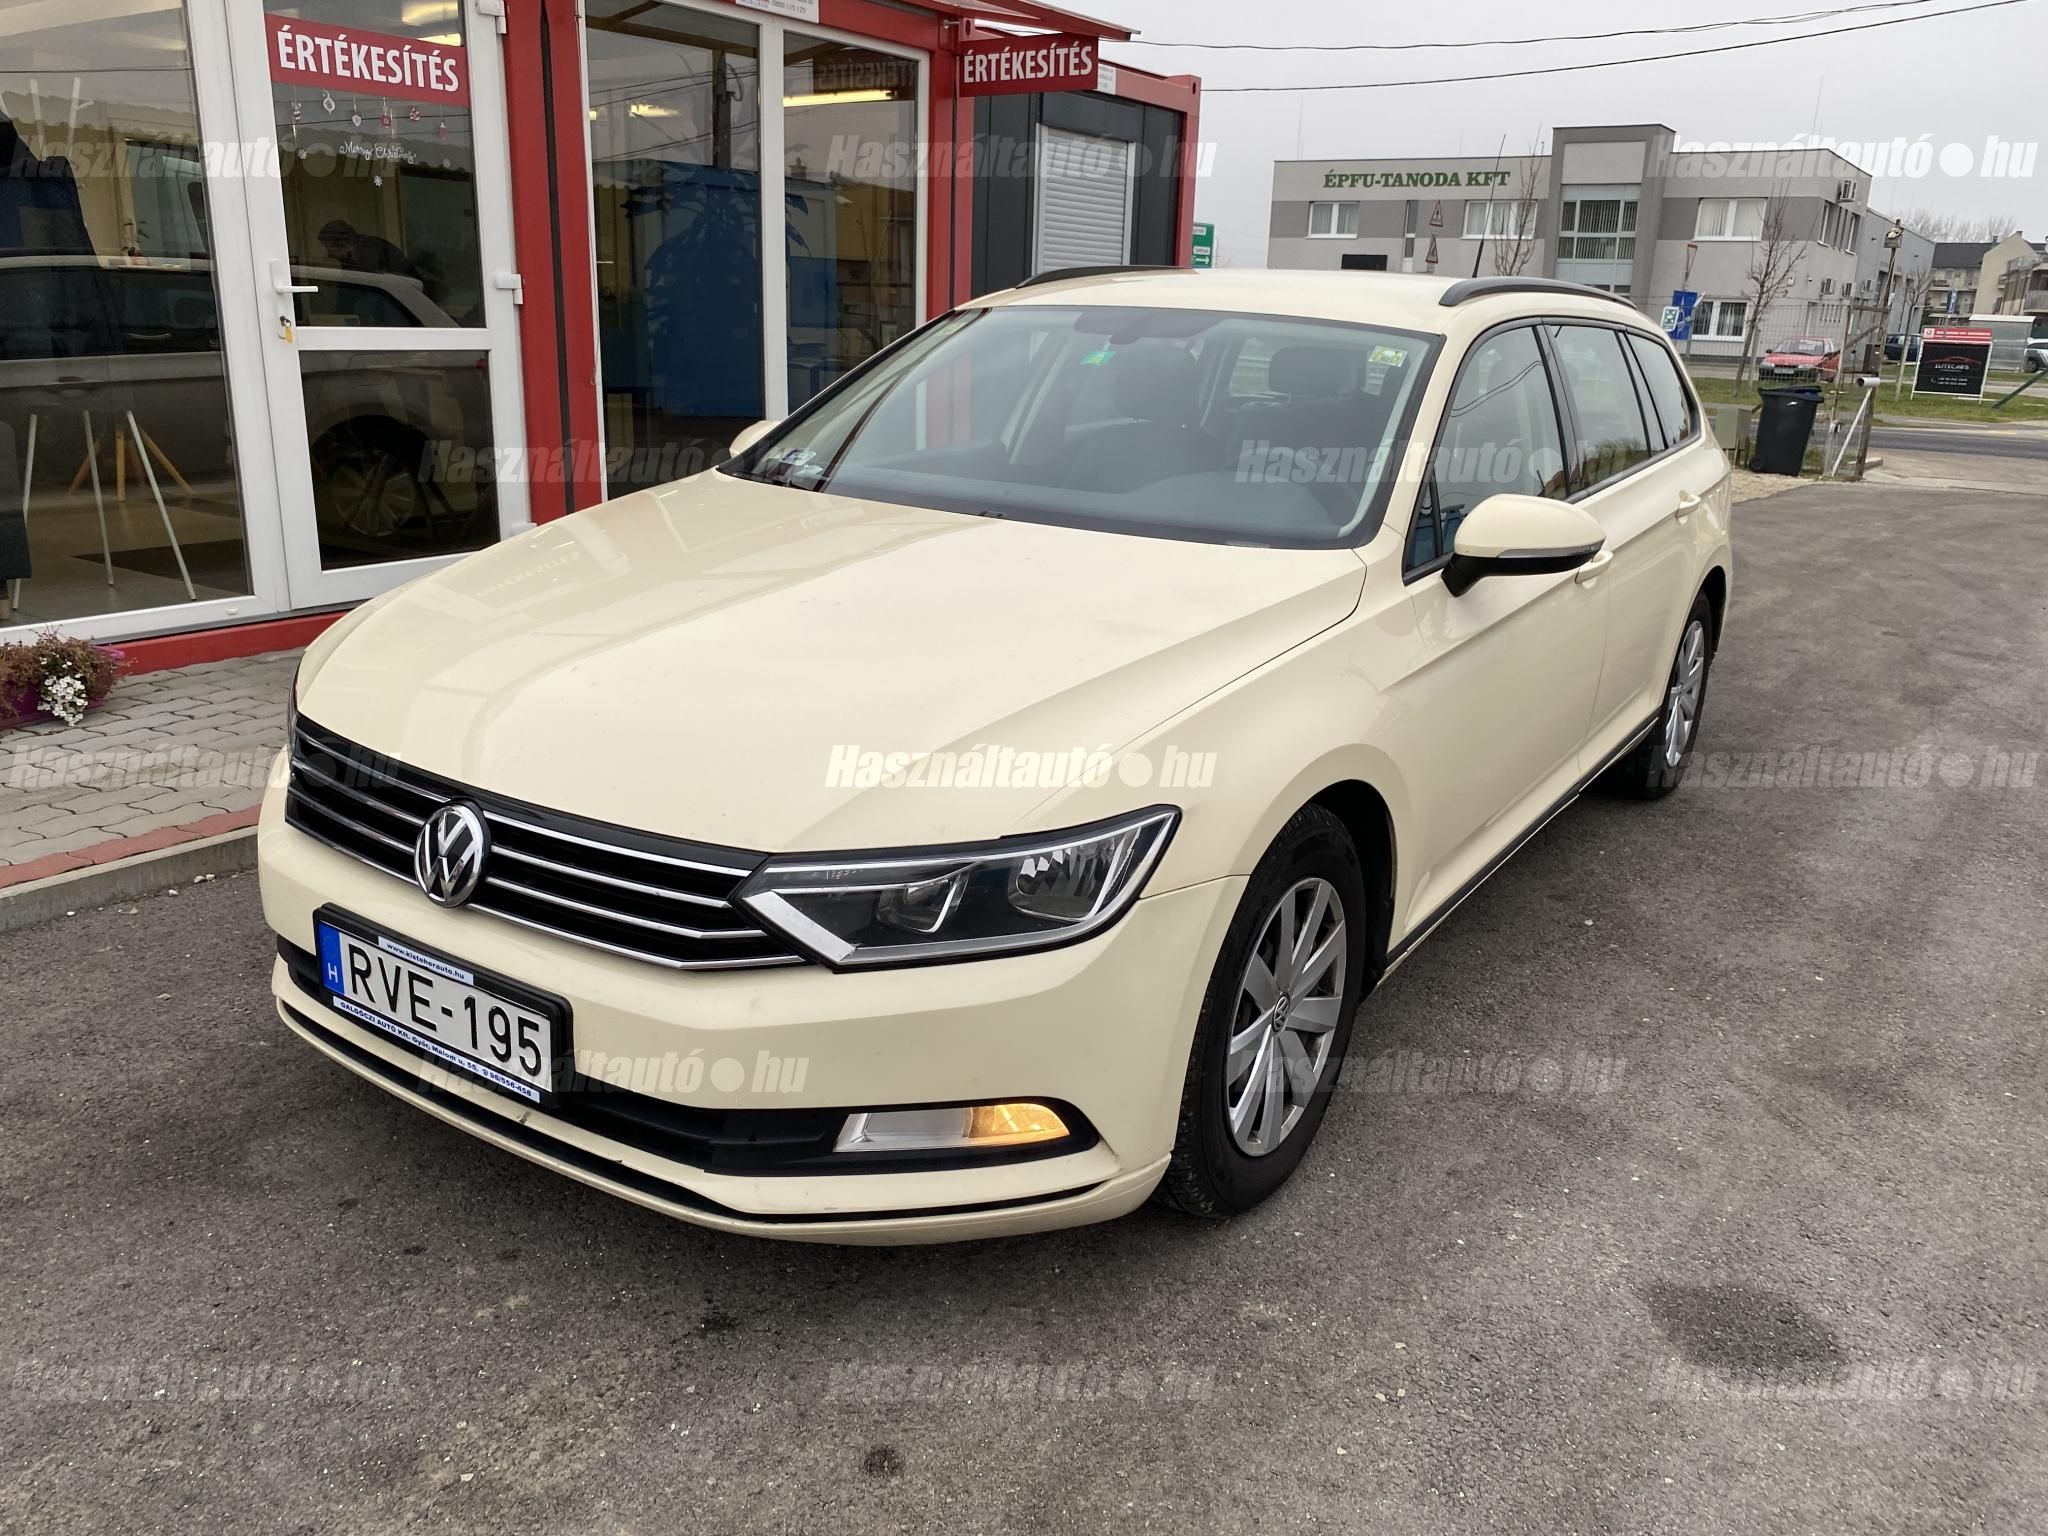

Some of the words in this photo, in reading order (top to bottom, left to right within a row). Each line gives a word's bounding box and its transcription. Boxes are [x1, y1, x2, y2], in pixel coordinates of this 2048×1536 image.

[278, 24, 460, 93] ÉRTÉKESÍTÉS
[963, 40, 1093, 82] ÉRTÉKESÍTÉS
[339, 141, 374, 160] Merry
[1323, 168, 1462, 188] ÉPFU-TANODA
[1465, 171, 1511, 187] KFT
[327, 963, 338, 984] H
[387, 943, 465, 979] www.kisteherauto.hu
[348, 942, 542, 1077] RVE-195
[431, 1045, 457, 1062] Malom
